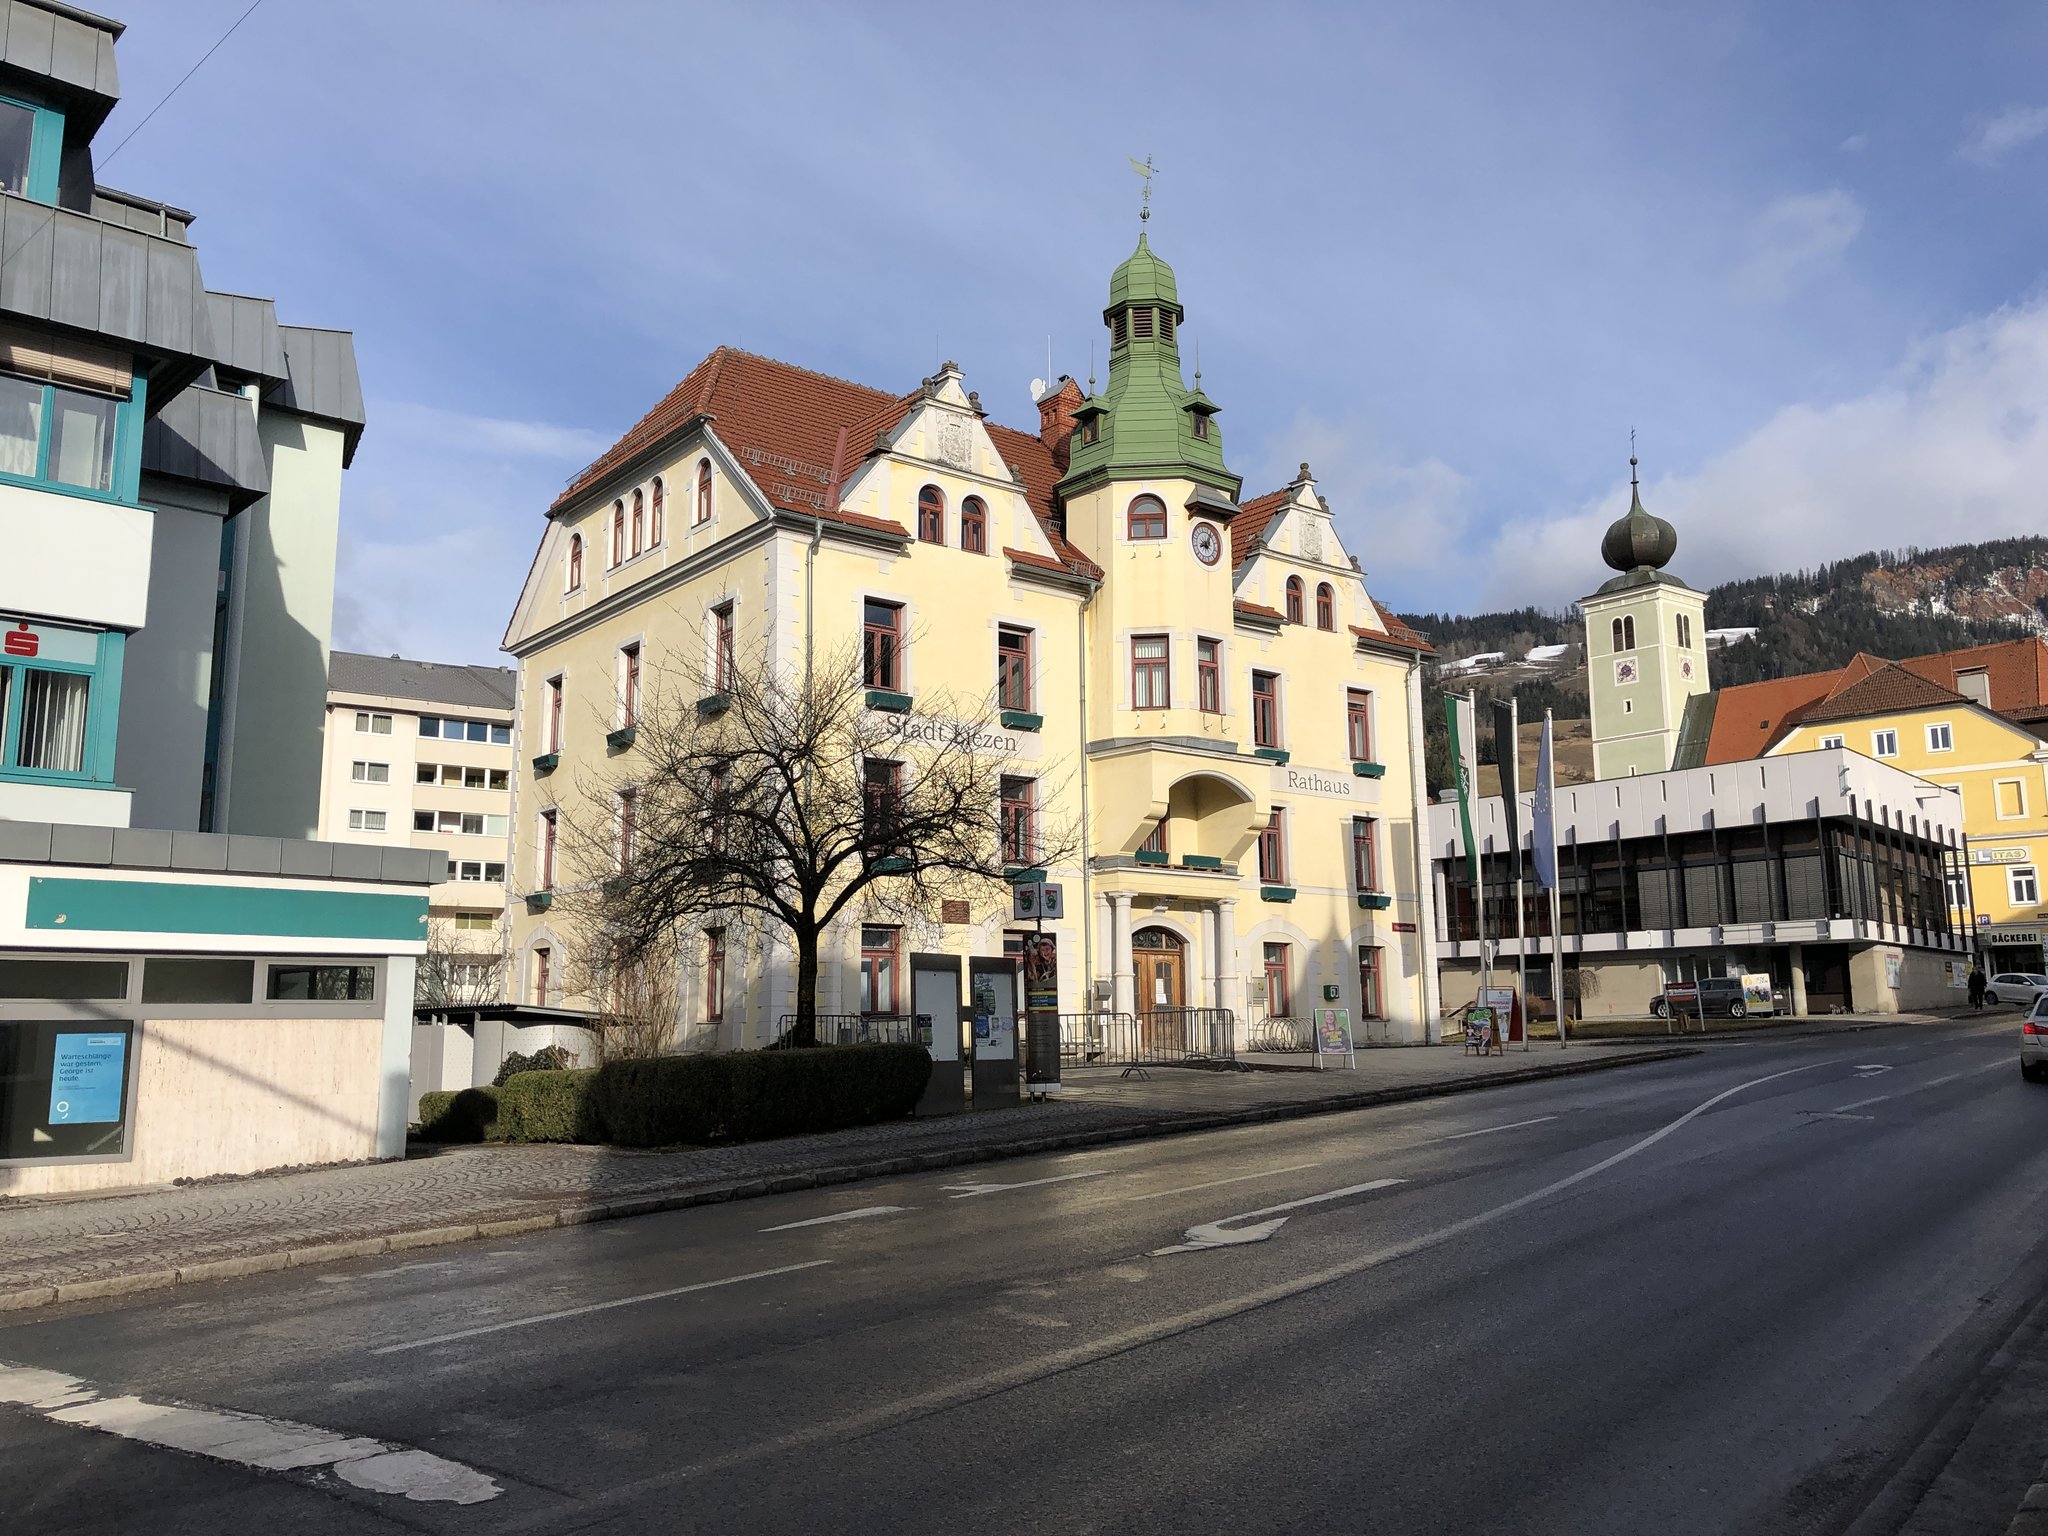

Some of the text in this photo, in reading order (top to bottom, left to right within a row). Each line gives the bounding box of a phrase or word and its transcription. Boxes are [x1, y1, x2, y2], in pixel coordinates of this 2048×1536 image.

[887, 715, 945, 742] Stadt
[1288, 771, 1350, 795] Rathaus
[1992, 932, 2037, 943] BÄCKEREI
